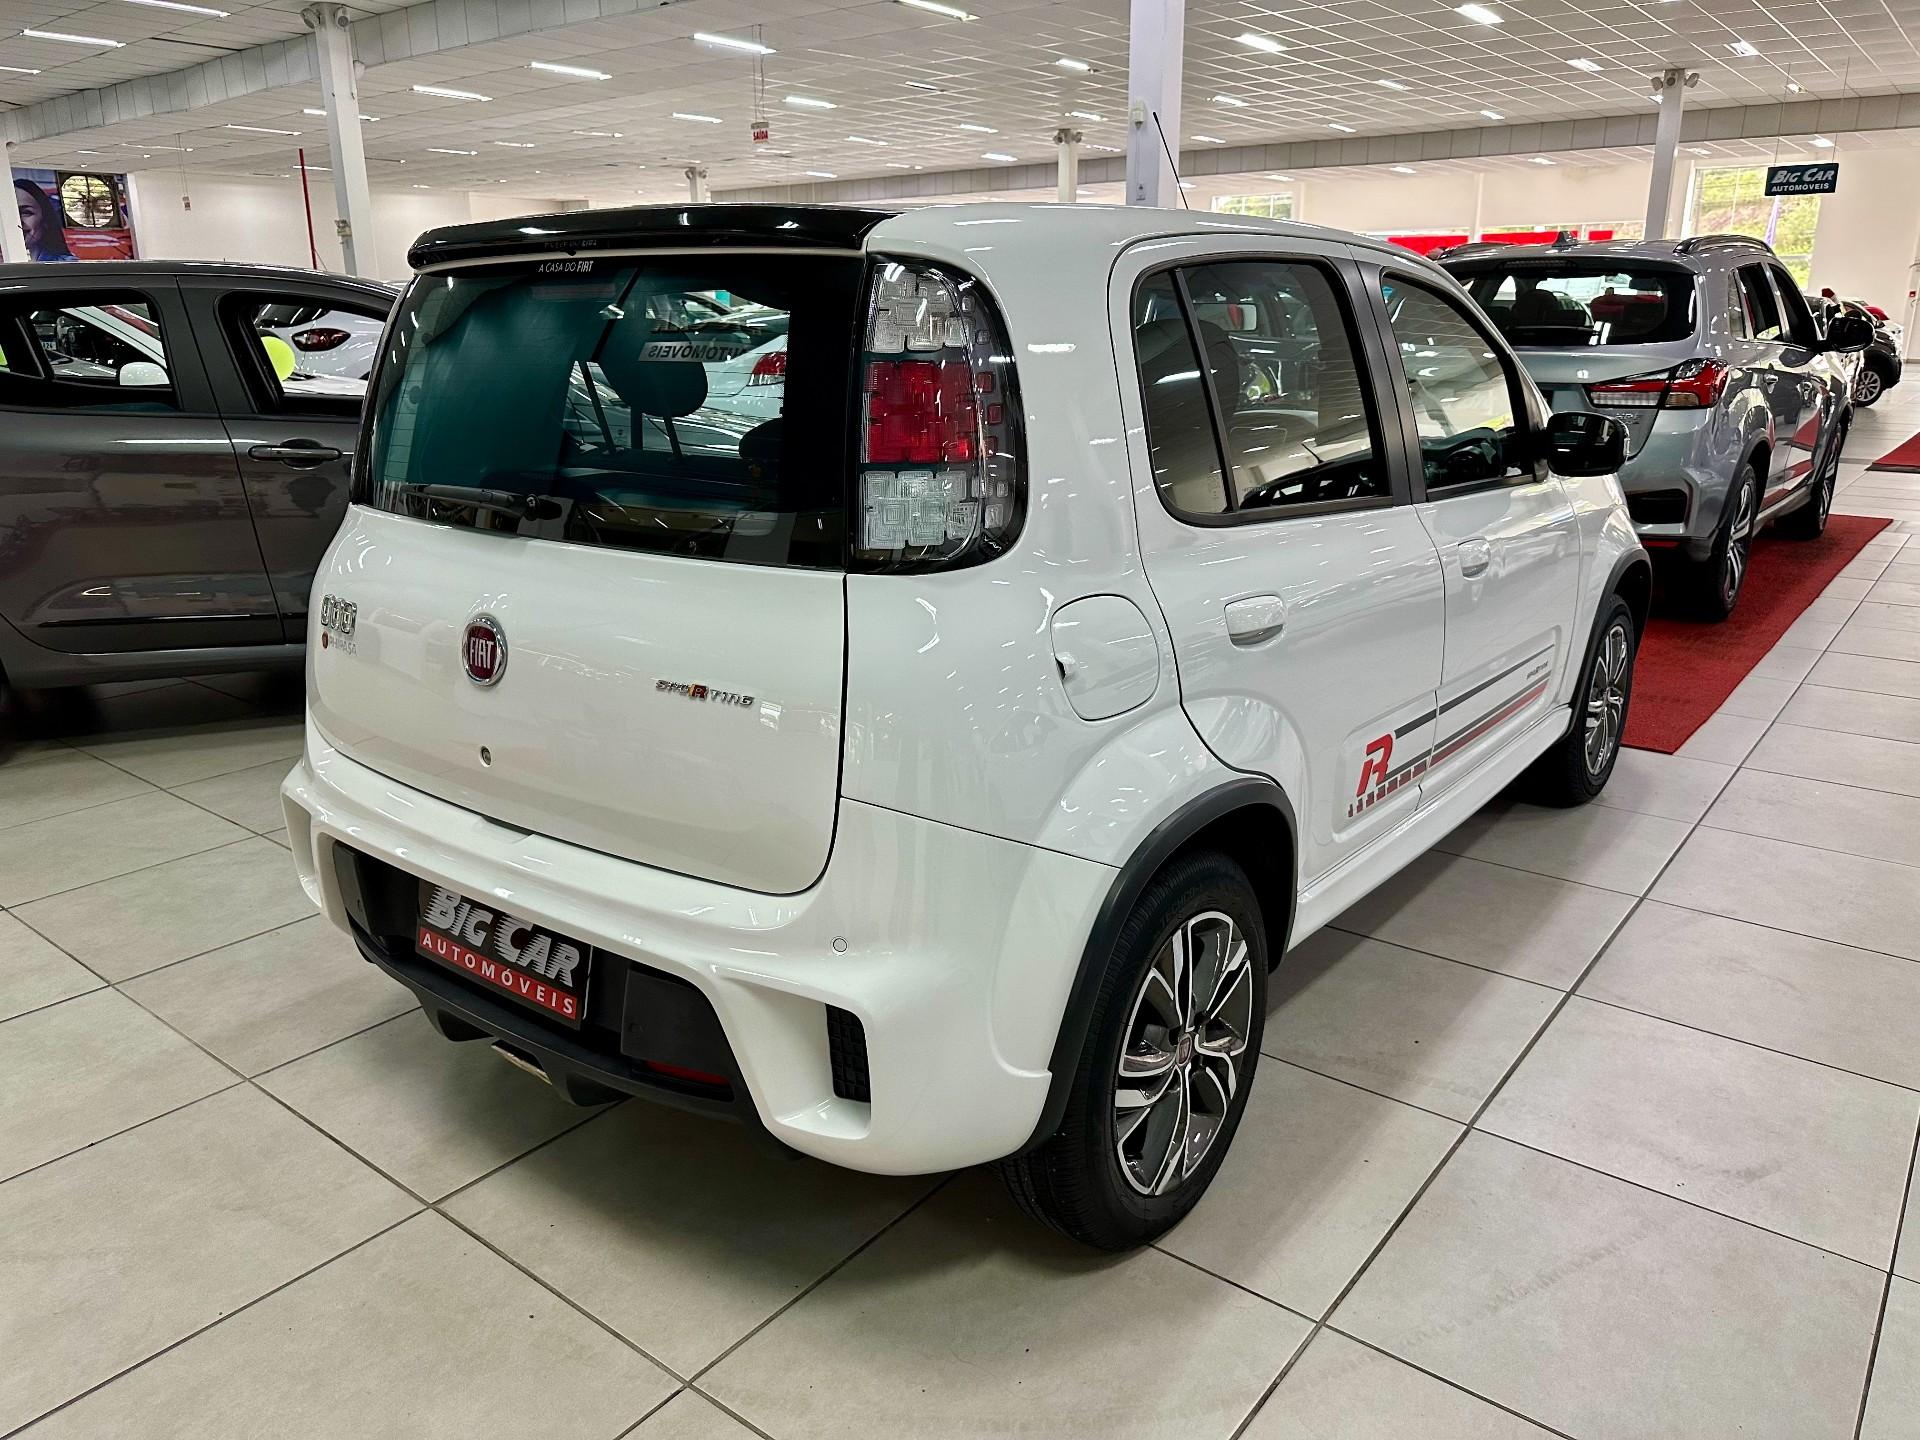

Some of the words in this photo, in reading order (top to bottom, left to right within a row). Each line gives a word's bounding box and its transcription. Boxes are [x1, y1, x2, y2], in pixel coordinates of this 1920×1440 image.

[1771, 170, 1801, 184] BIG
[1802, 167, 1835, 182] CAR
[538, 263, 544, 273] A
[545, 262, 563, 273] CASA
[564, 261, 577, 272] DO
[576, 260, 595, 273] FIAT
[469, 636, 495, 669] FIAT
[423, 886, 494, 948] BIG
[493, 912, 580, 988] CAR
[422, 933, 574, 1014] AUTOMÓVEIS
